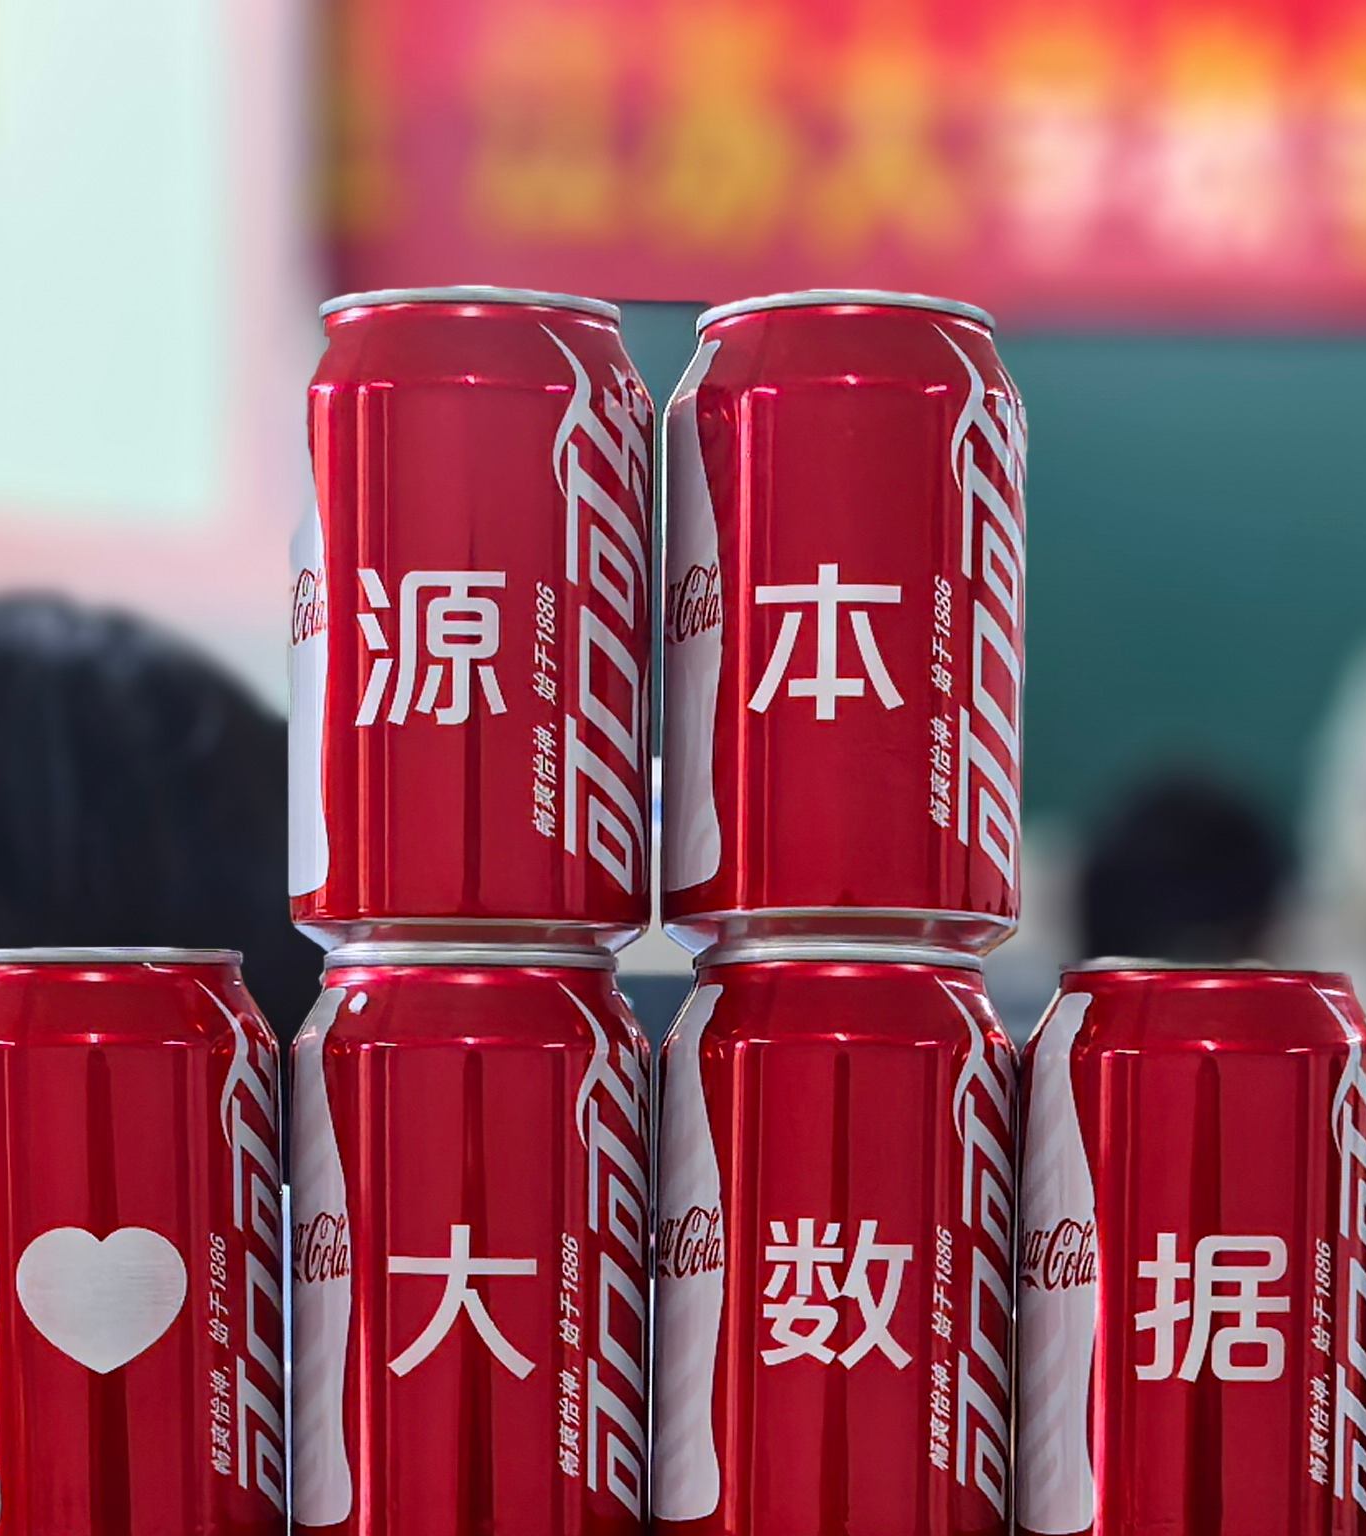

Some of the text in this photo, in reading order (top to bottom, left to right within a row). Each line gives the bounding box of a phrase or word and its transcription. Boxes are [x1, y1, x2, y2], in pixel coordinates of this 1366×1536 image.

[354, 563, 905, 727] 源 本
[387, 1217, 1290, 1383] 大 数 据
